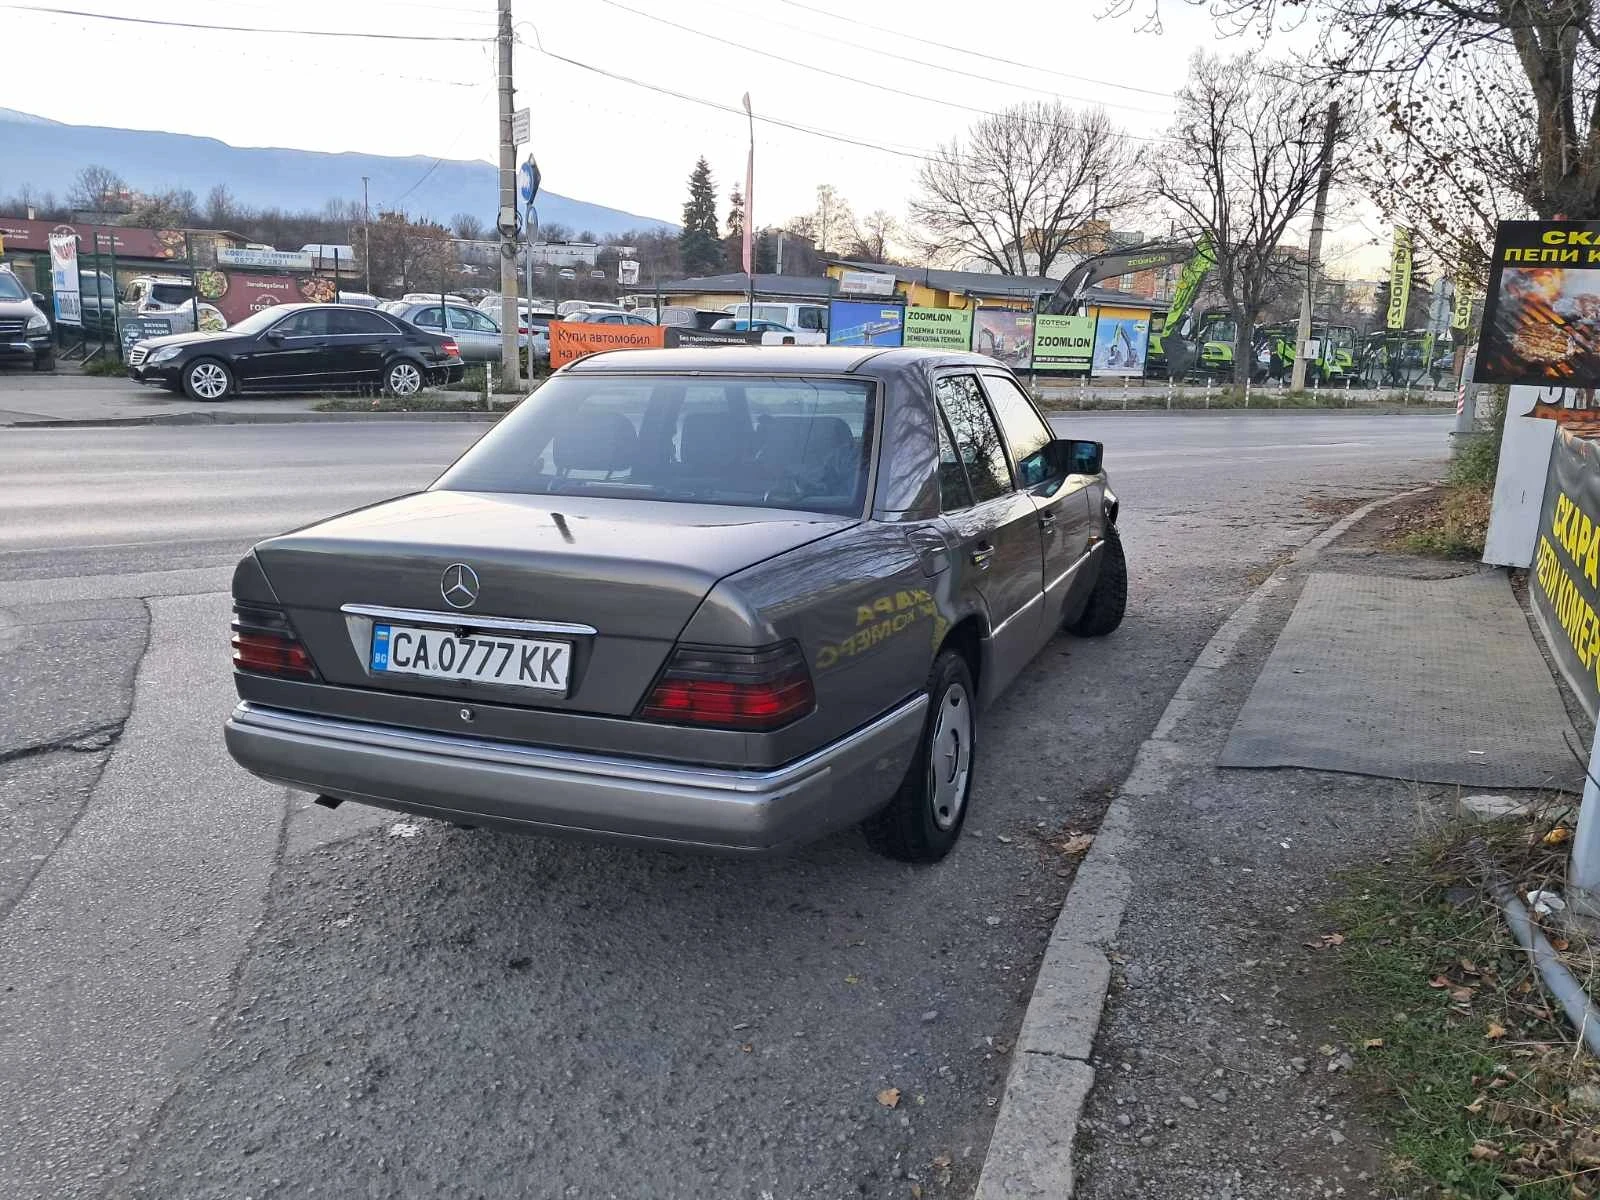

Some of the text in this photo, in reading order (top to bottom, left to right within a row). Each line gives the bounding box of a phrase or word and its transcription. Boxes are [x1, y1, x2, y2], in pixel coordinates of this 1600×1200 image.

[1504, 248, 1579, 262] ПЕПИ
[908, 311, 952, 322] ZOOMLION
[558, 329, 650, 345] Купи автомобил
[1037, 336, 1091, 348] ZOOMLION
[559, 350, 573, 358] на
[1553, 492, 1600, 590] СКАРА
[1536, 534, 1561, 605] ПЕПИ
[375, 652, 387, 664] BG
[393, 632, 562, 684] CA 0777 KK
